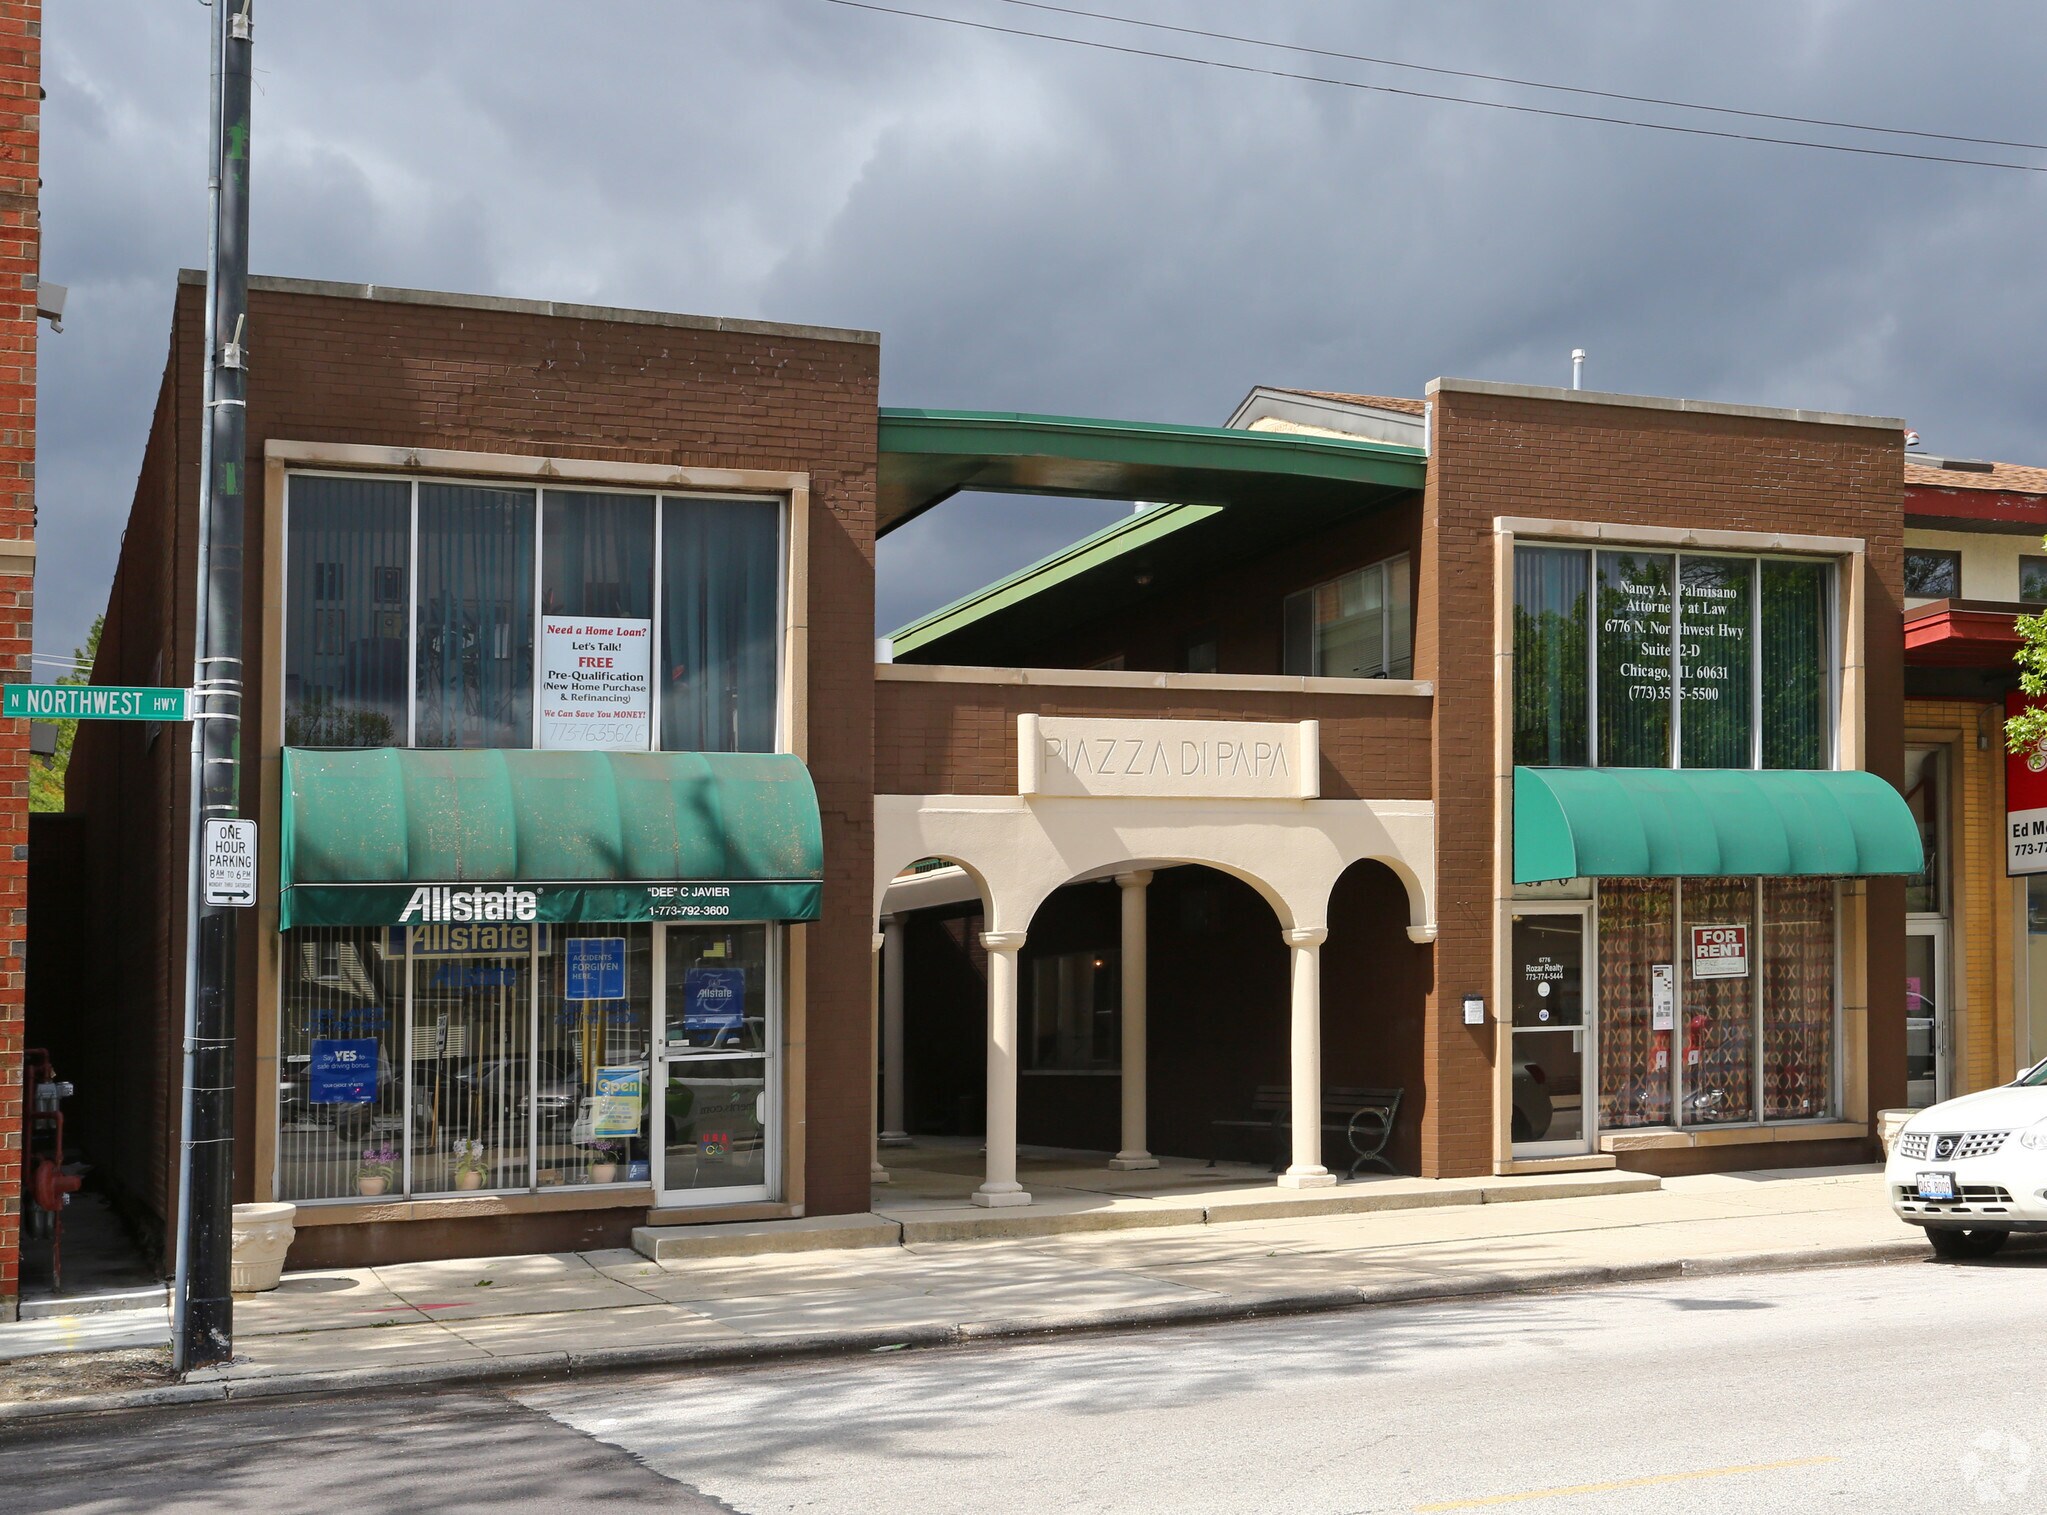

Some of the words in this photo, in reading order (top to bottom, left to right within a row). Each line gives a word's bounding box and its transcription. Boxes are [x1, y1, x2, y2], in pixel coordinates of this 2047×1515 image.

[1620, 580, 1656, 598] Nancy
[1657, 583, 1672, 596] A.
[1680, 583, 1737, 599] Palmisano
[1626, 599, 1684, 615] Attorney
[1688, 603, 1700, 614] at
[1703, 601, 1727, 615] Law
[547, 624, 573, 634] Need
[585, 626, 614, 636] Home
[617, 627, 647, 637] Loan?
[1605, 619, 1631, 632] 6776
[1634, 621, 1646, 633] N.
[1650, 621, 1715, 636] Northwest
[1718, 624, 1744, 640] Hwy
[572, 642, 595, 651] Let's
[598, 642, 621, 651] Talk!
[1641, 642, 1671, 657] Suite
[1680, 644, 1700, 657] 2-D
[579, 657, 614, 668] FREE
[548, 671, 644, 681] Pre-Qualification
[1620, 663, 1671, 681] Chicago,
[1680, 665, 1694, 679] IL
[1696, 666, 1728, 680] 60631
[543, 682, 568, 690] (New
[572, 683, 600, 691] Home
[603, 684, 647, 692] Purchase
[11, 693, 19, 707] N
[27, 689, 143, 715] NORTHWEST
[153, 698, 177, 711] HWY
[560, 693, 568, 701] &
[571, 694, 631, 704] Refinancing)
[1044, 738, 1170, 775] PIAZZA
[1181, 740, 1208, 776] DI
[1217, 741, 1289, 777] PAPA
[220, 826, 242, 840] ONE
[2013, 823, 2028, 837] Ed
[2033, 821, 2047, 835] M
[216, 841, 246, 854] HOUR
[209, 855, 252, 868] PARKING
[210, 869, 215, 879] 8
[227, 871, 234, 879] TO
[236, 871, 242, 880] 6
[647, 887, 678, 897] "DEE"
[680, 887, 689, 897] C
[691, 887, 730, 897] JAVIER
[398, 886, 537, 922] Allstate
[649, 906, 729, 916] 1-773-792-3600
[412, 924, 528, 951] Allstate
[1702, 931, 1737, 944] FOR
[1697, 943, 1743, 958] RENT
[572, 963, 618, 971] FORGIVEN
[1525, 964, 1544, 972] Rozar
[1544, 964, 1564, 973] Realty
[697, 988, 732, 998] Allstate
[322, 1054, 334, 1062] Say
[335, 1050, 357, 1062] YES
[331, 1063, 350, 1071] driving
[598, 1079, 638, 1095] Open
